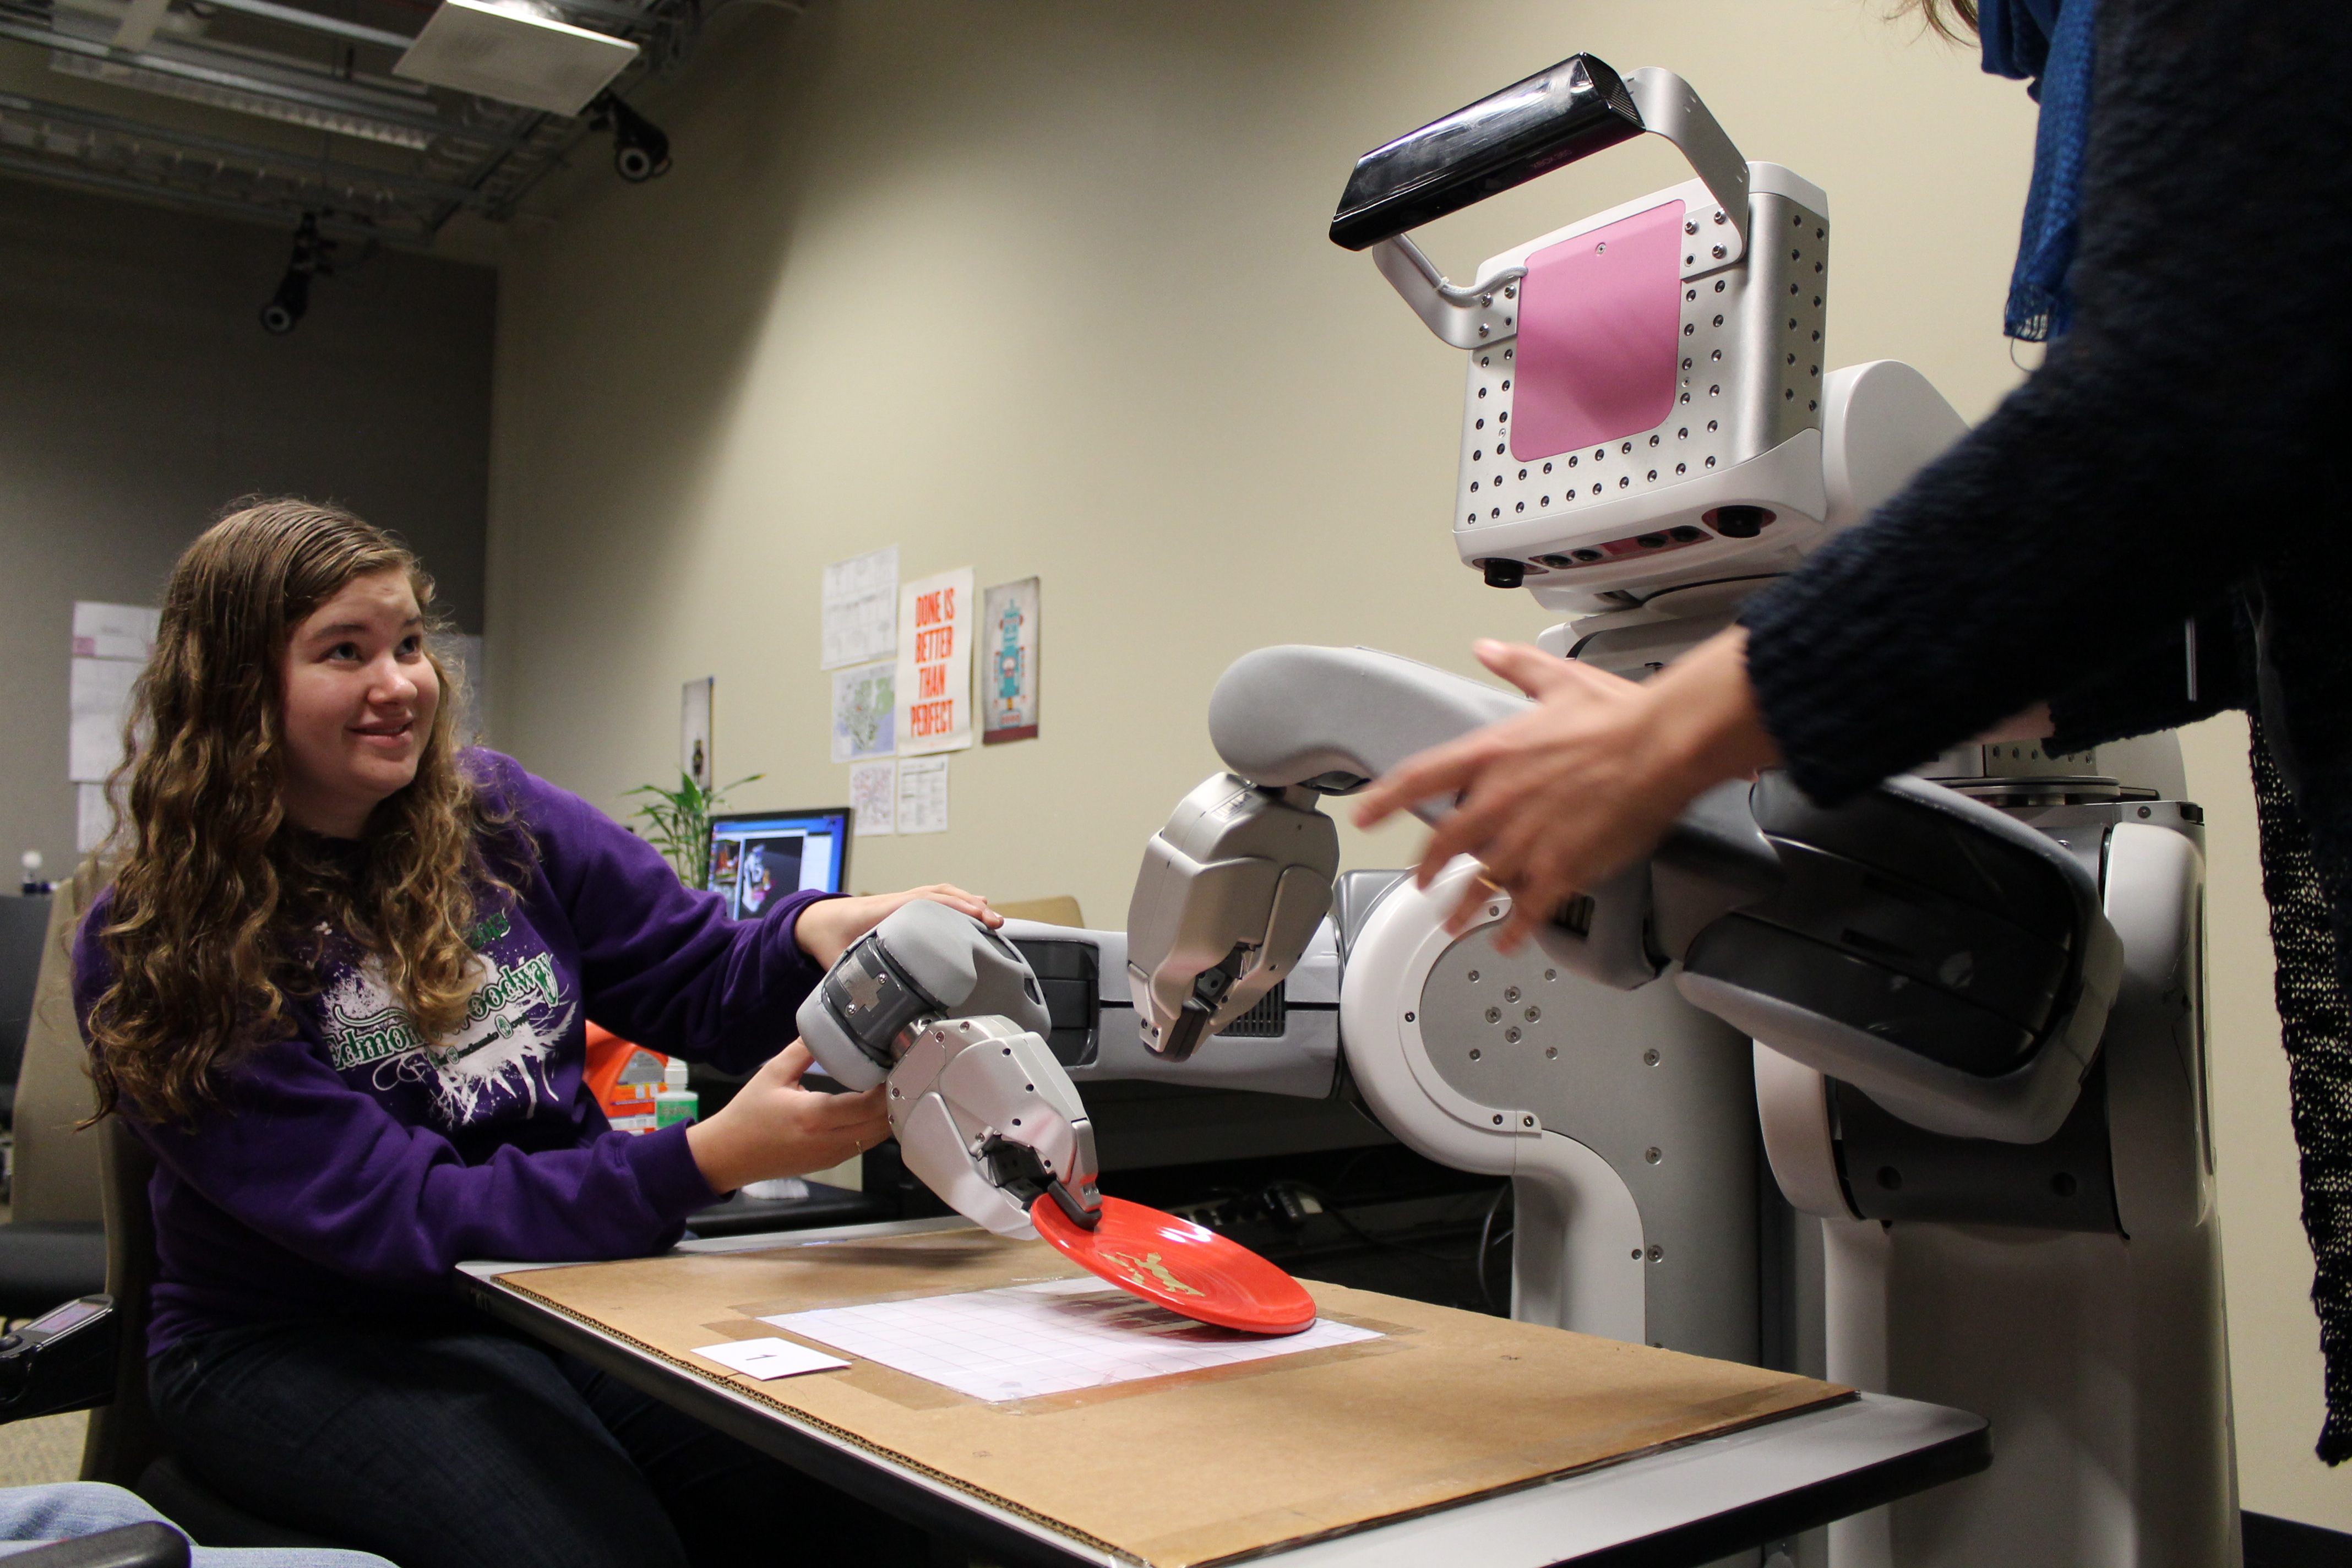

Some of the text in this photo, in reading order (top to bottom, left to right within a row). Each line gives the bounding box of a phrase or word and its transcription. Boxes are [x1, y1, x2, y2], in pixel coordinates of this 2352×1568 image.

[916, 590, 942, 628] DONE
[944, 587, 955, 621] IS
[915, 625, 954, 664] BETTER
[918, 663, 946, 700] THAN
[910, 699, 954, 738] PERFECT
